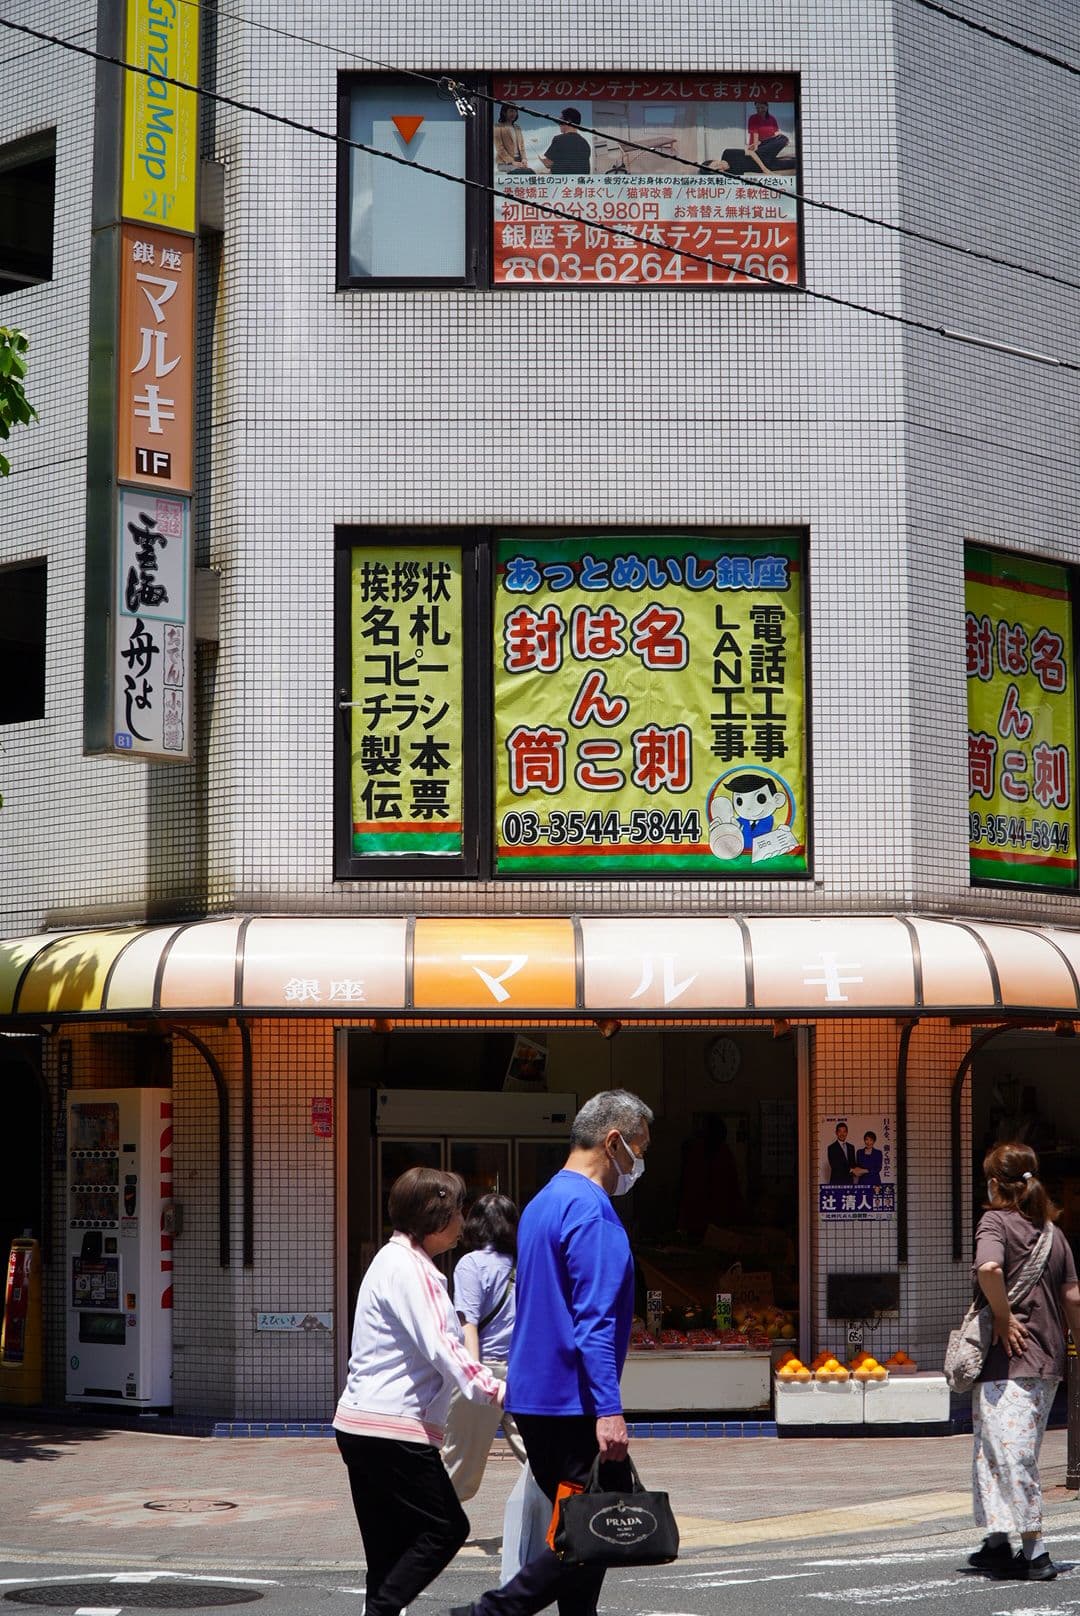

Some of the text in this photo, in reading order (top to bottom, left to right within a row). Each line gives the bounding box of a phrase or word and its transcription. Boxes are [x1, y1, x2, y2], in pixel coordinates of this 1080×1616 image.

[503, 80, 785, 98] カラダのメンテナンスしてますか？
[143, 188, 175, 219] 2F
[674, 204, 788, 219] お着替え無料貸出し
[502, 224, 790, 250] 銀座予防整体テクニカル
[132, 240, 183, 272] 銀座
[537, 253, 789, 283] 03-6264-1766
[131, 272, 182, 435] マルキ
[138, 449, 169, 475] 1F
[361, 561, 451, 603] 挨拶状
[504, 556, 790, 591] あっとめいし銀座
[361, 605, 450, 647] 名札
[364, 648, 449, 687] コピー
[749, 605, 789, 762] 電話工事
[362, 693, 450, 731] チラシ
[117, 735, 131, 748] B1
[361, 735, 451, 777] 製本
[360, 779, 450, 820] 伝票
[503, 810, 702, 845] 03-3544-5844
[282, 977, 366, 1003] 銀座
[606, 1517, 642, 1526] PRADA
